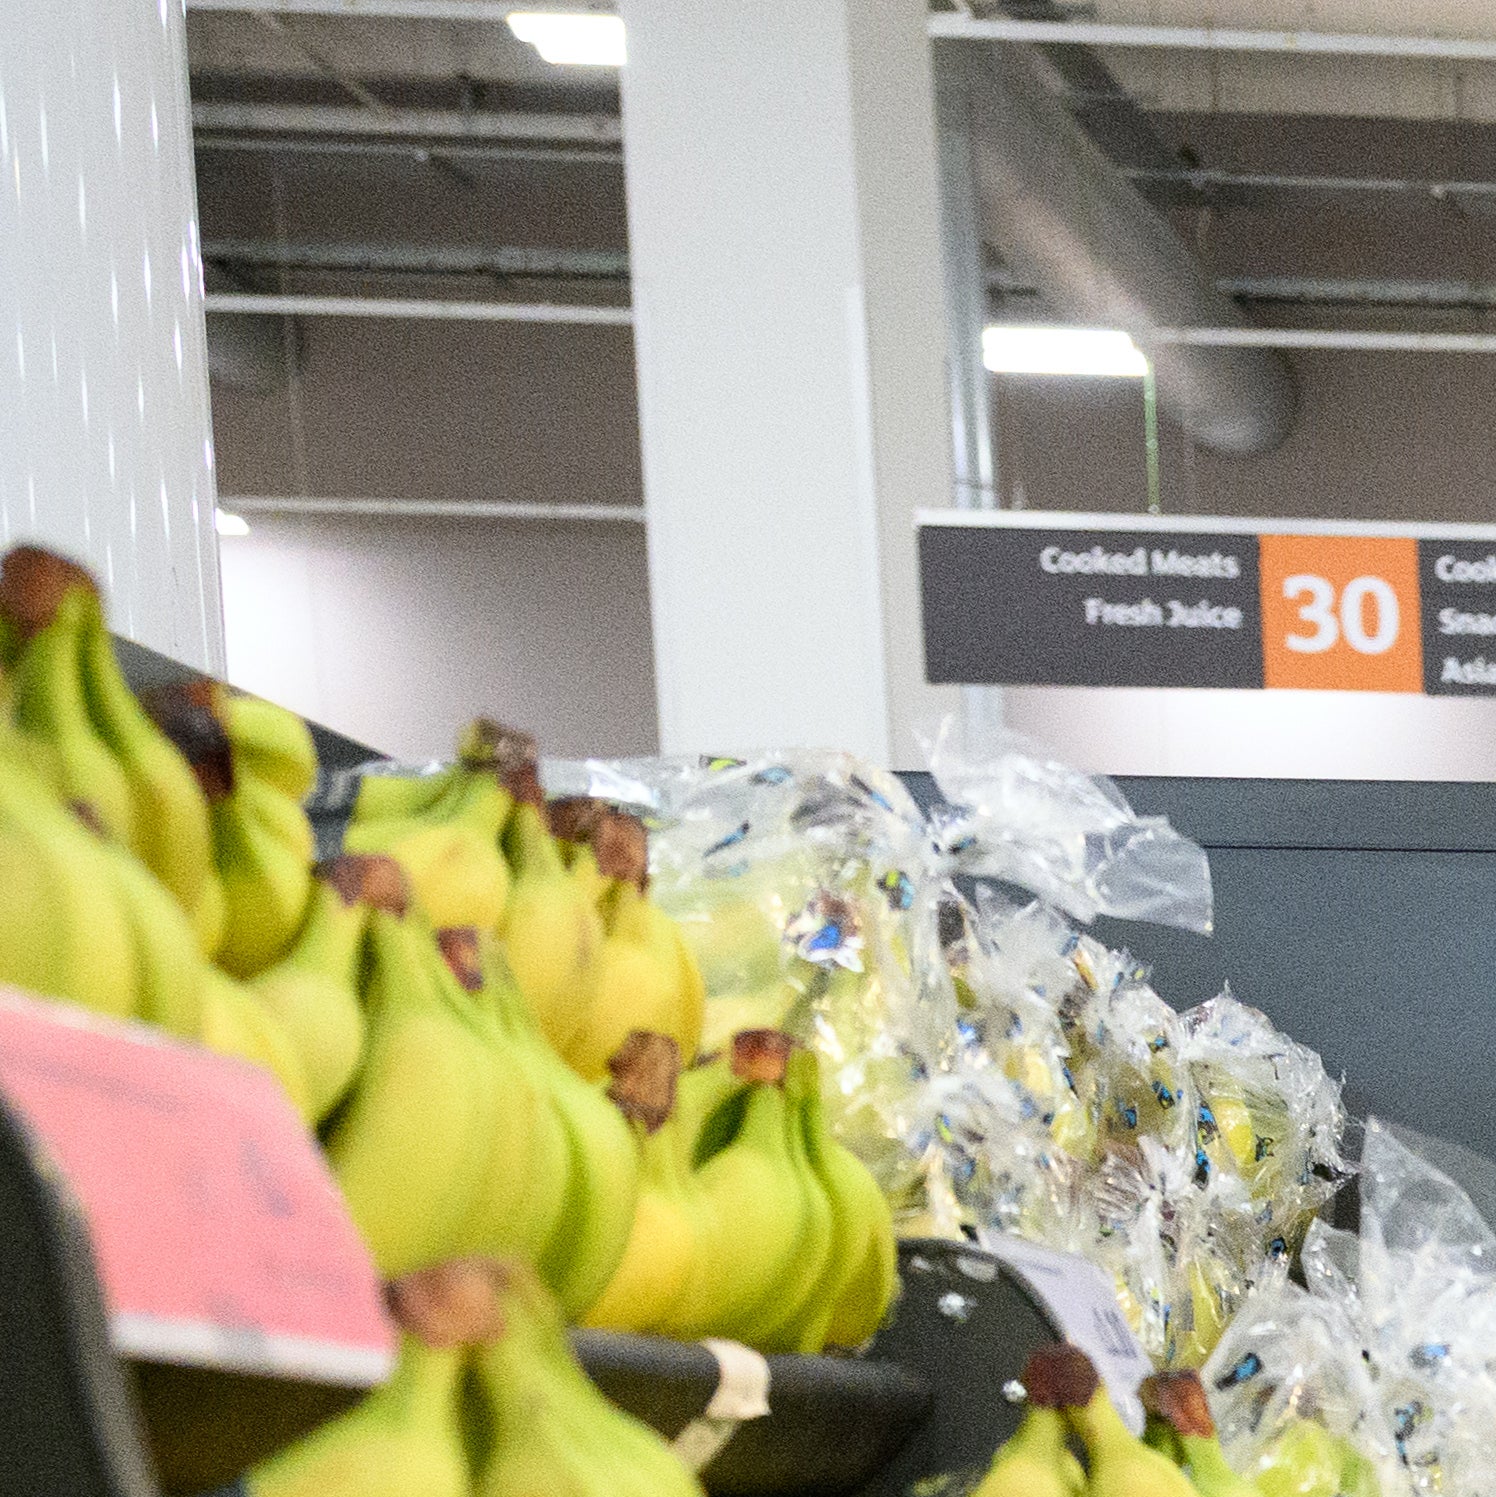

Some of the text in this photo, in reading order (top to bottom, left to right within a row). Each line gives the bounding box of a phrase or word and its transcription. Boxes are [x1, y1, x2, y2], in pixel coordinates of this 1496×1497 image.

[1040, 546, 1240, 578] Cooked Meats
[1083, 598, 1242, 629] Fresh Juice
[1284, 575, 1399, 654] 30
